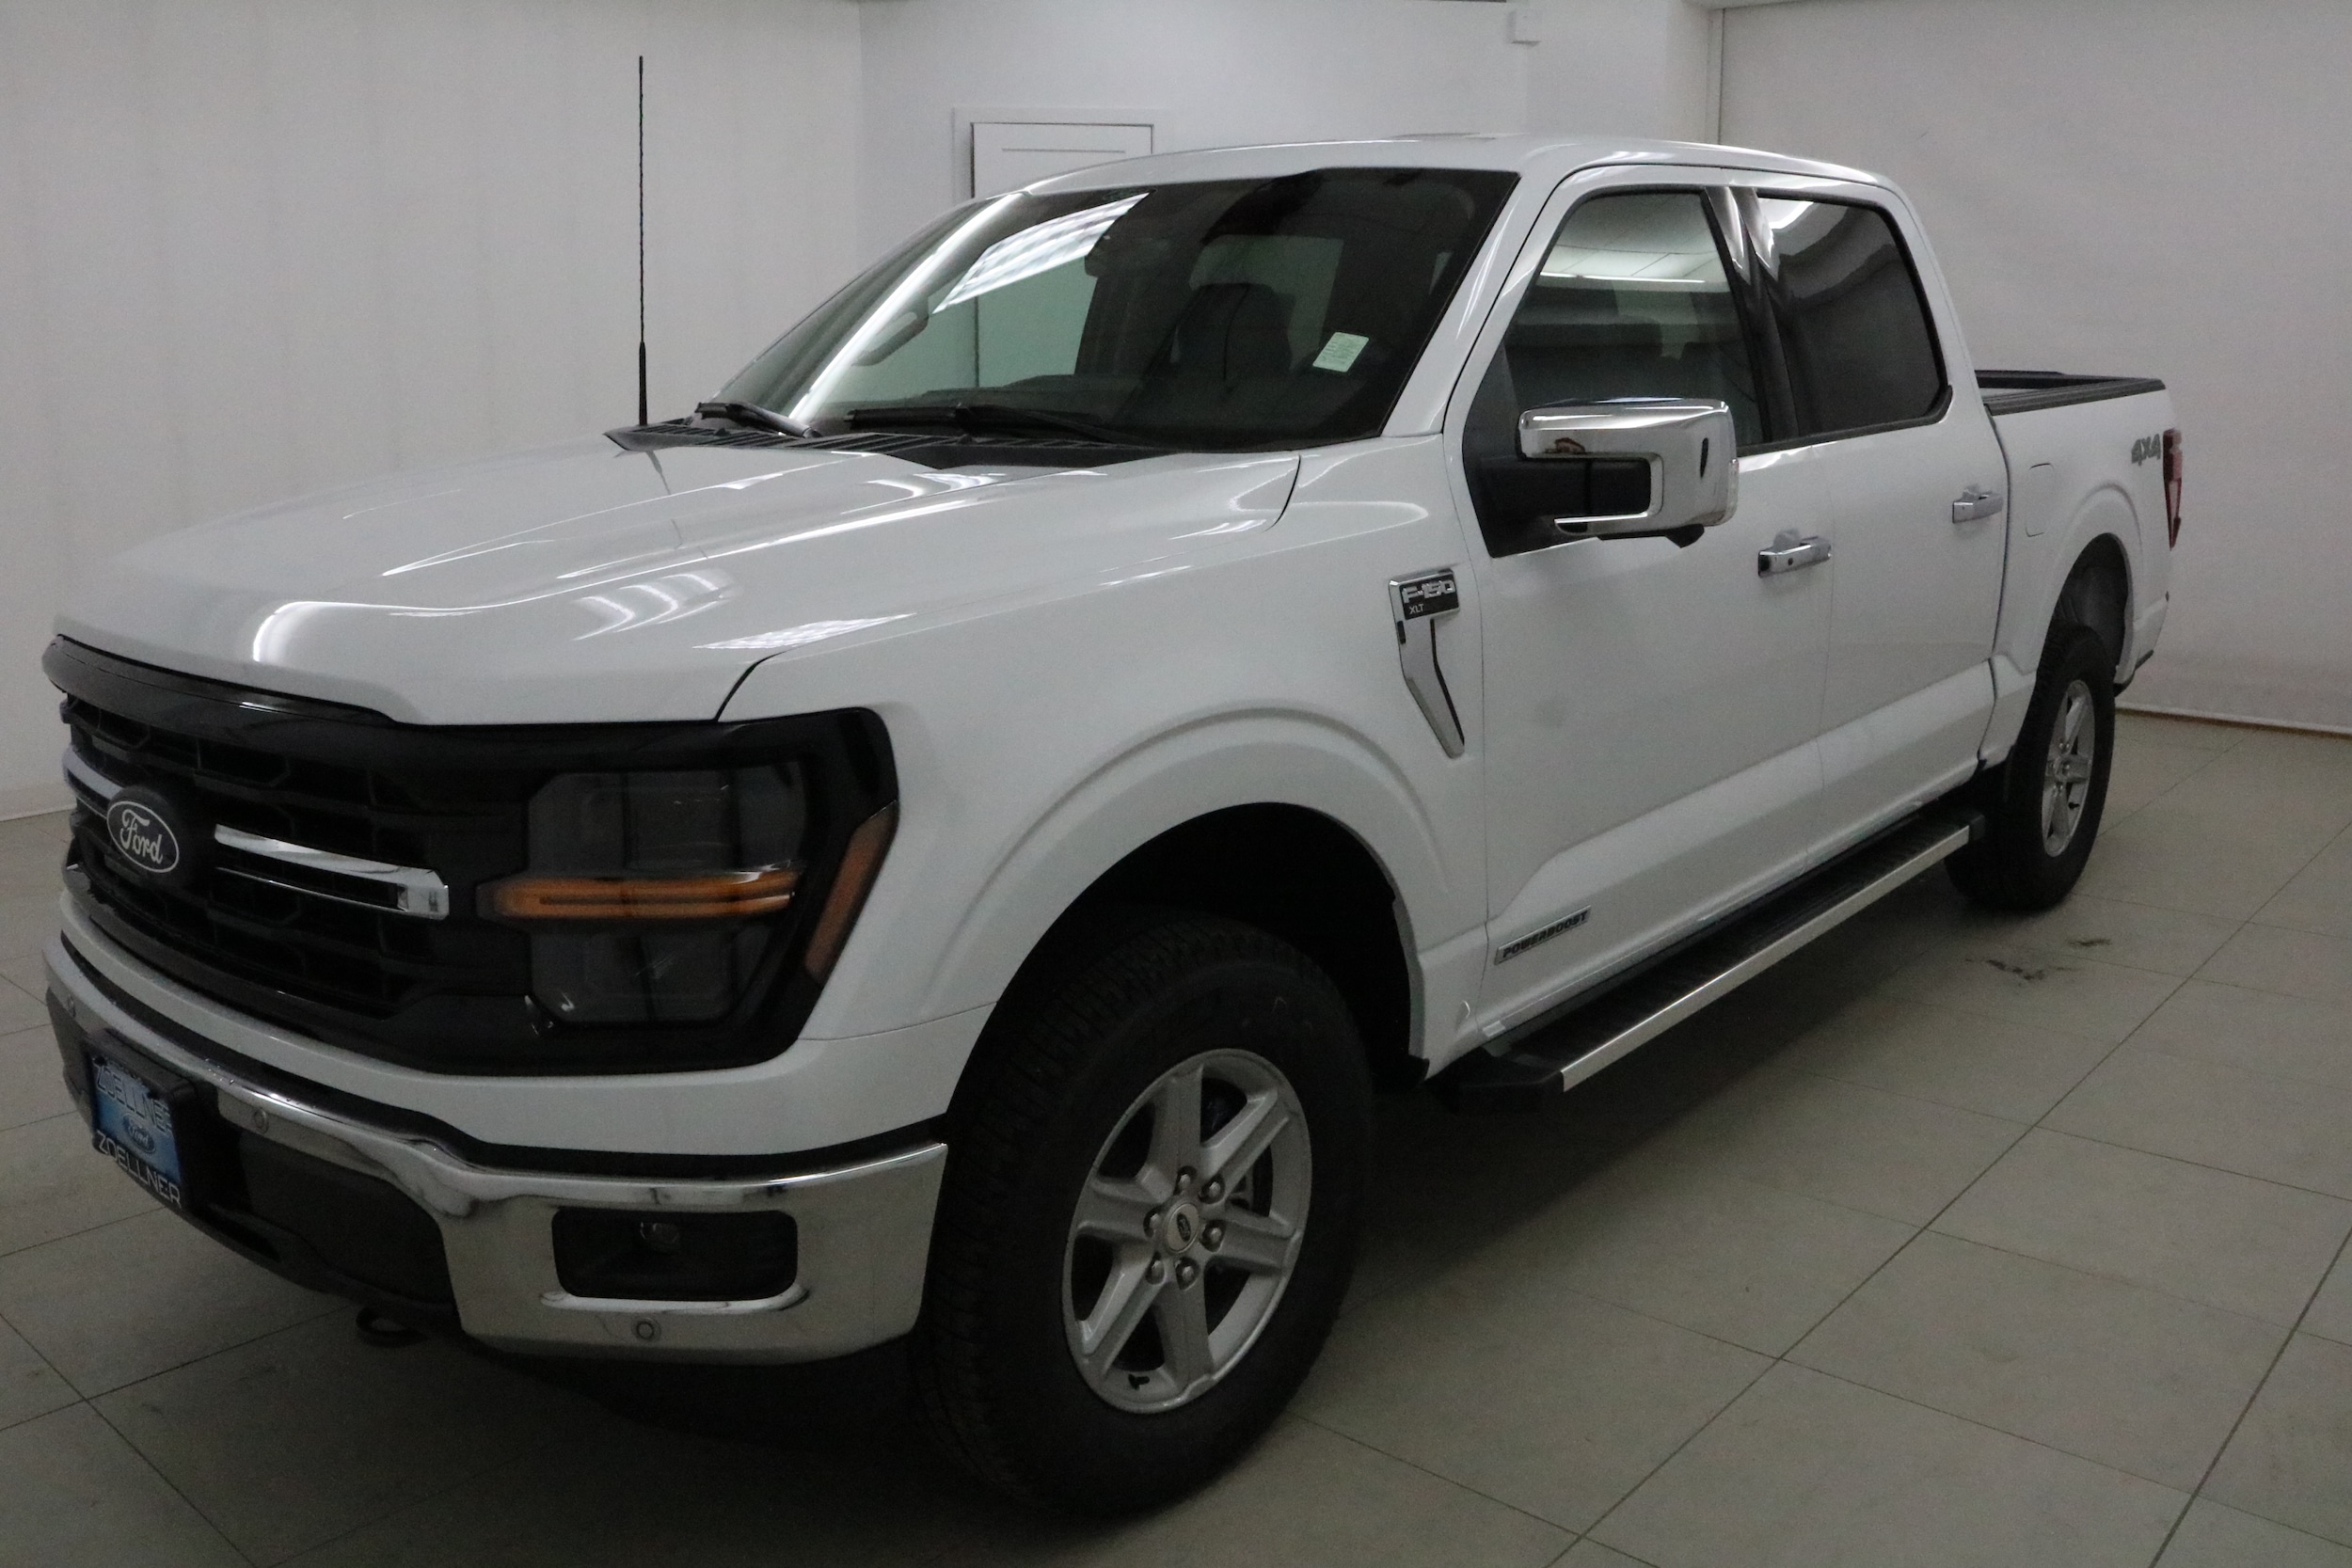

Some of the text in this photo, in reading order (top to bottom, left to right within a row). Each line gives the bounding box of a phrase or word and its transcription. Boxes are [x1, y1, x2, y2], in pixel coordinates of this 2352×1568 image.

[1402, 579, 1456, 603] F-150
[1409, 603, 1424, 614] XLT
[119, 809, 164, 864] Ford
[1502, 910, 1588, 958] POWERBOOST
[97, 1130, 183, 1209] ZOELLNER
